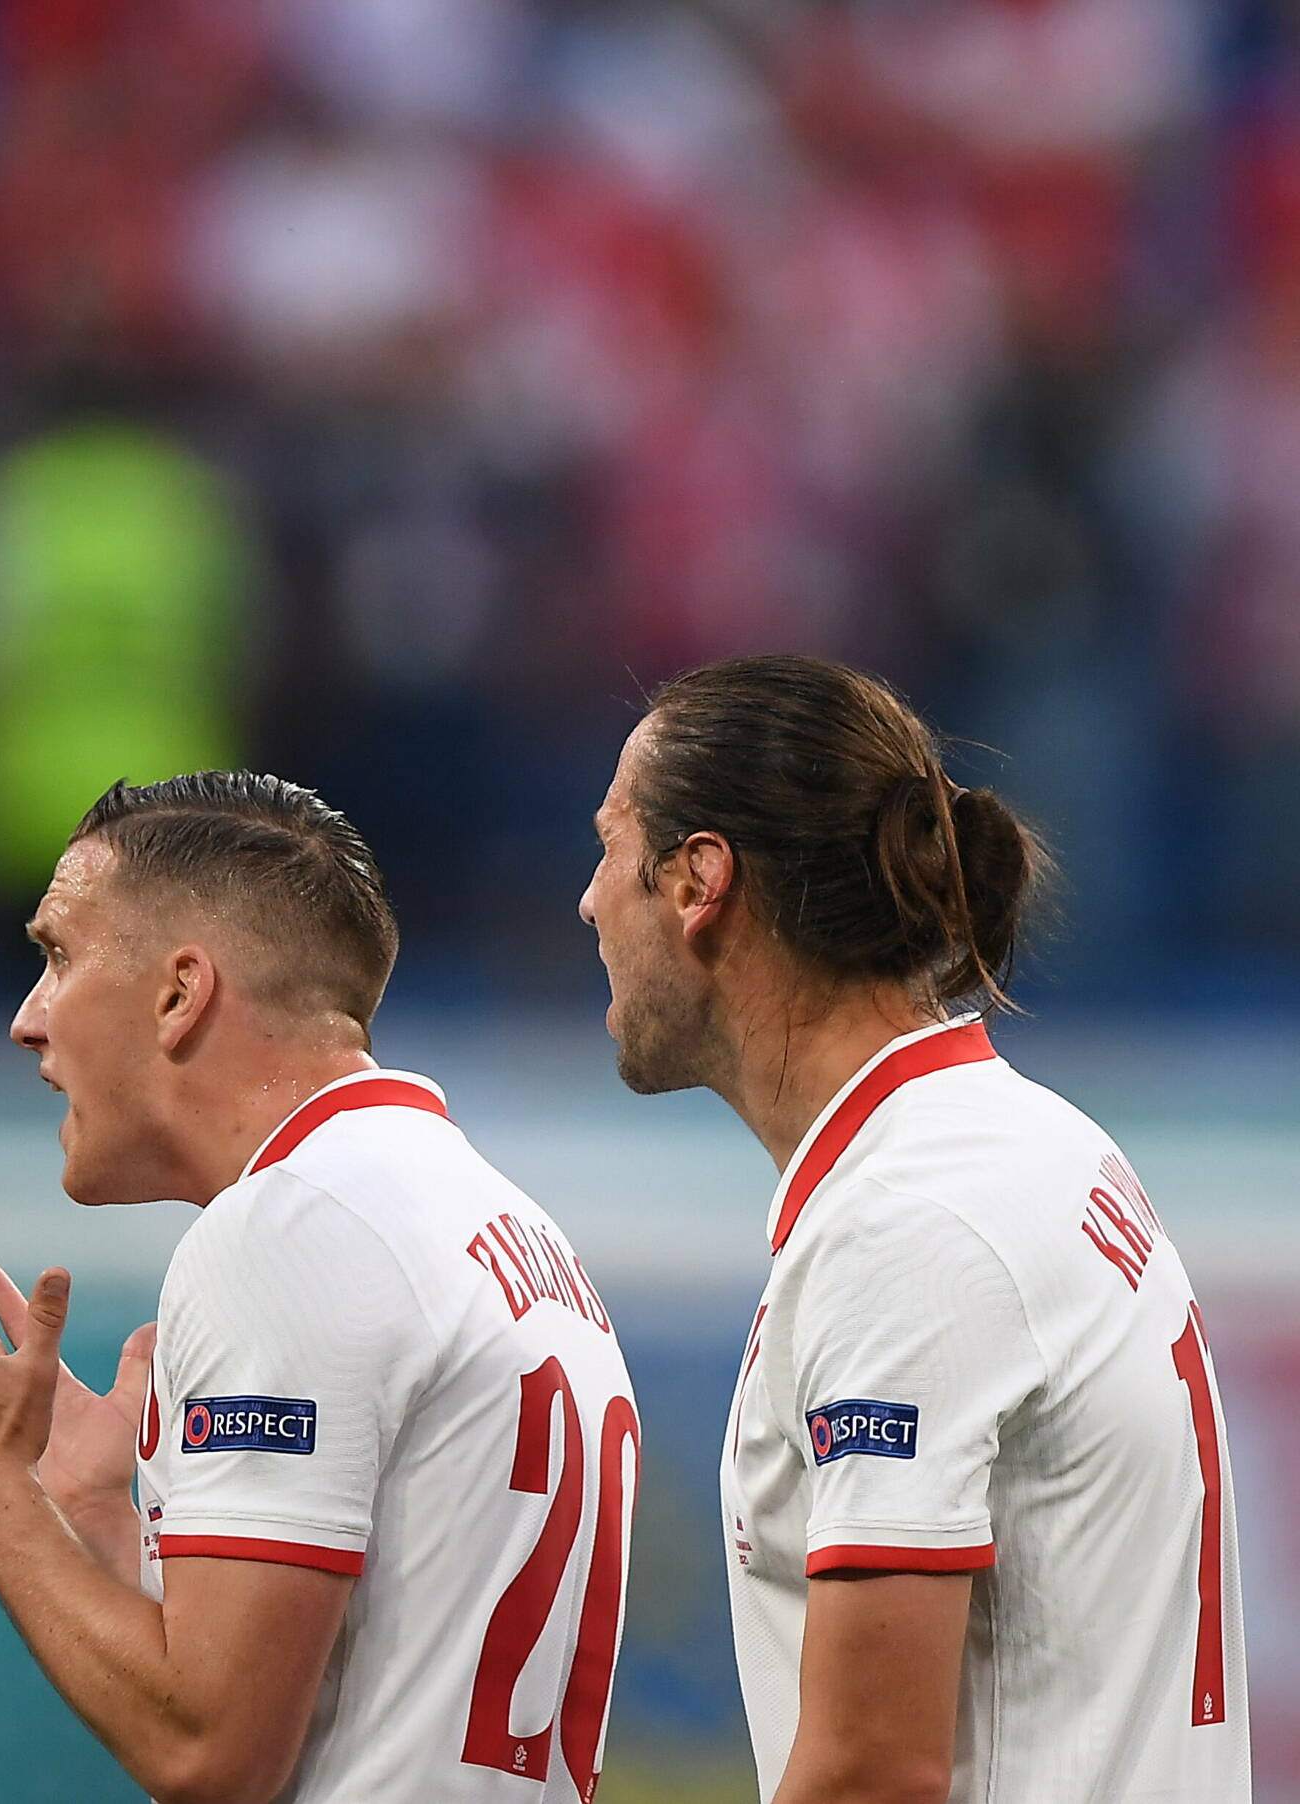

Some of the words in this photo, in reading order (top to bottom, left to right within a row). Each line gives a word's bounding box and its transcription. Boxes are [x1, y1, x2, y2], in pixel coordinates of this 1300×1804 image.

[212, 1411, 314, 1440] RESPECT
[831, 1414, 916, 1445] RESPECT
[1170, 1299, 1225, 1728] 1
[460, 1355, 641, 1804] 20
